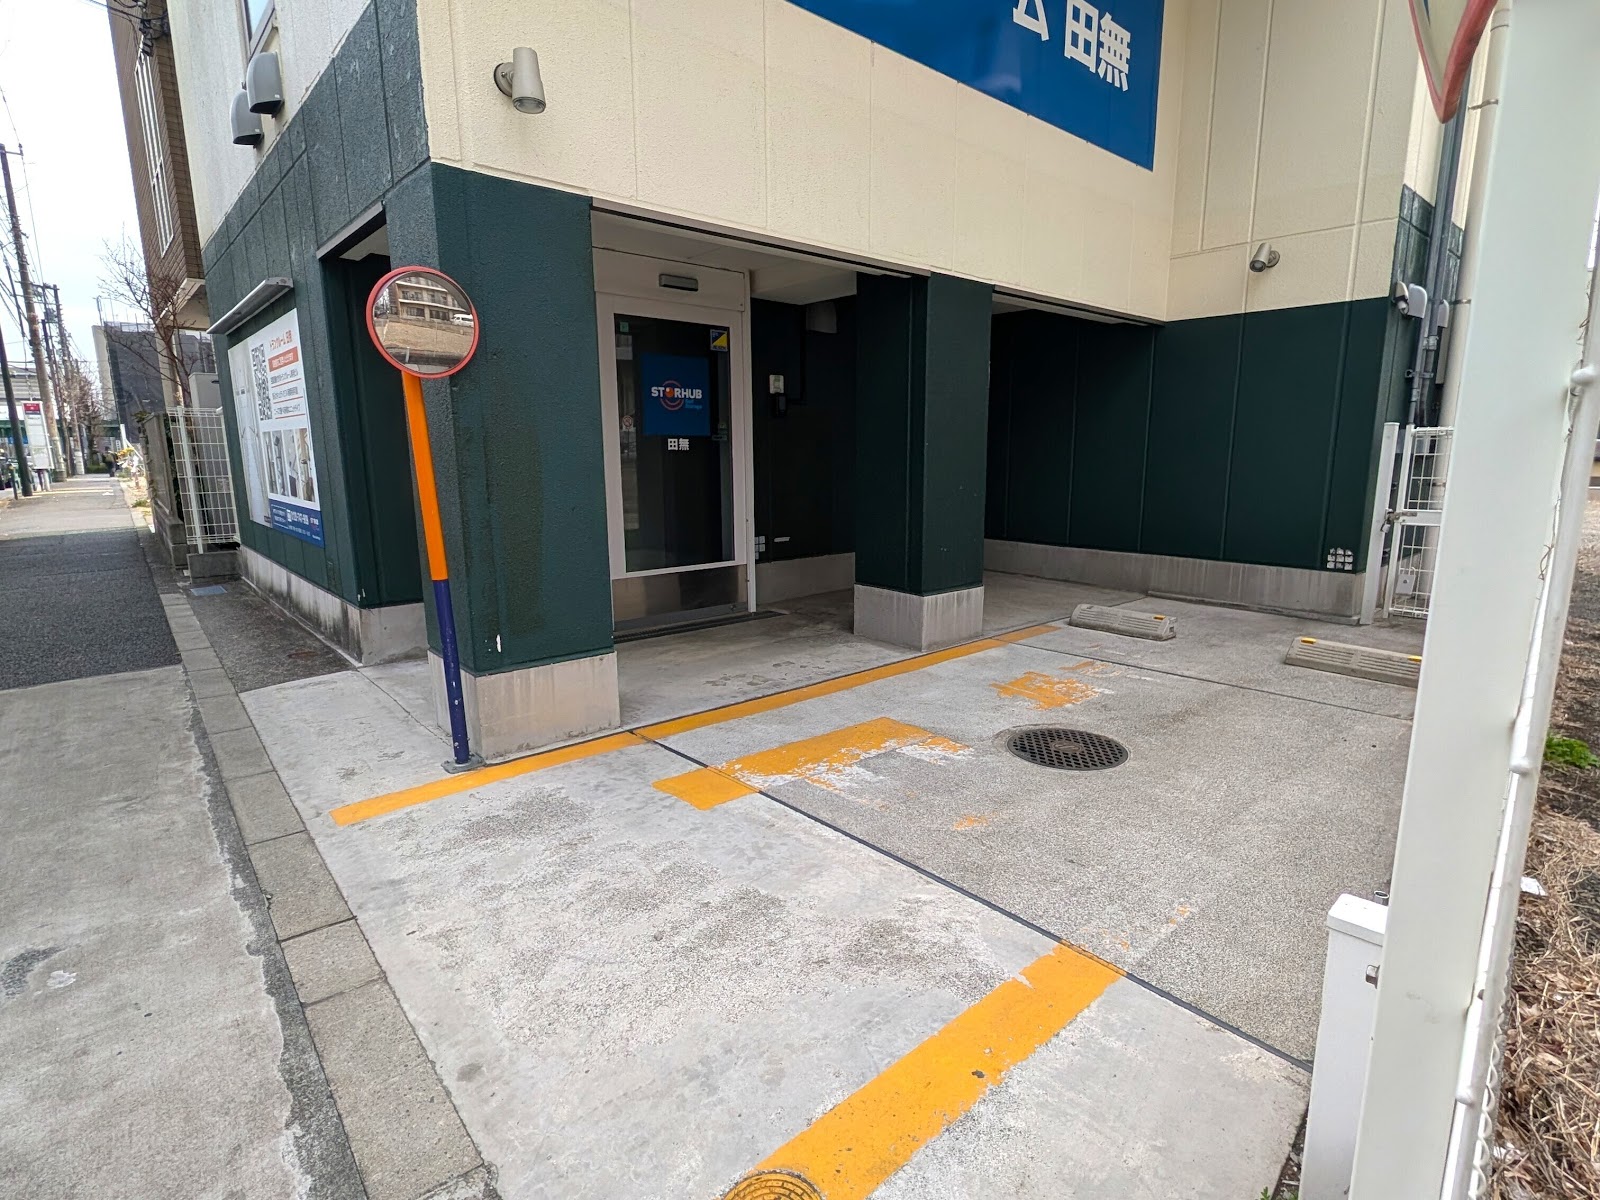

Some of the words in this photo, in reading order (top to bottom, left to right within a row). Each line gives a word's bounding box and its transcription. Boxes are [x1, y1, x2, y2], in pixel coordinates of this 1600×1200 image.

[1064, 0, 1131, 92] 田無
[651, 386, 703, 400] STORHUB
[667, 438, 690, 451] 田無
